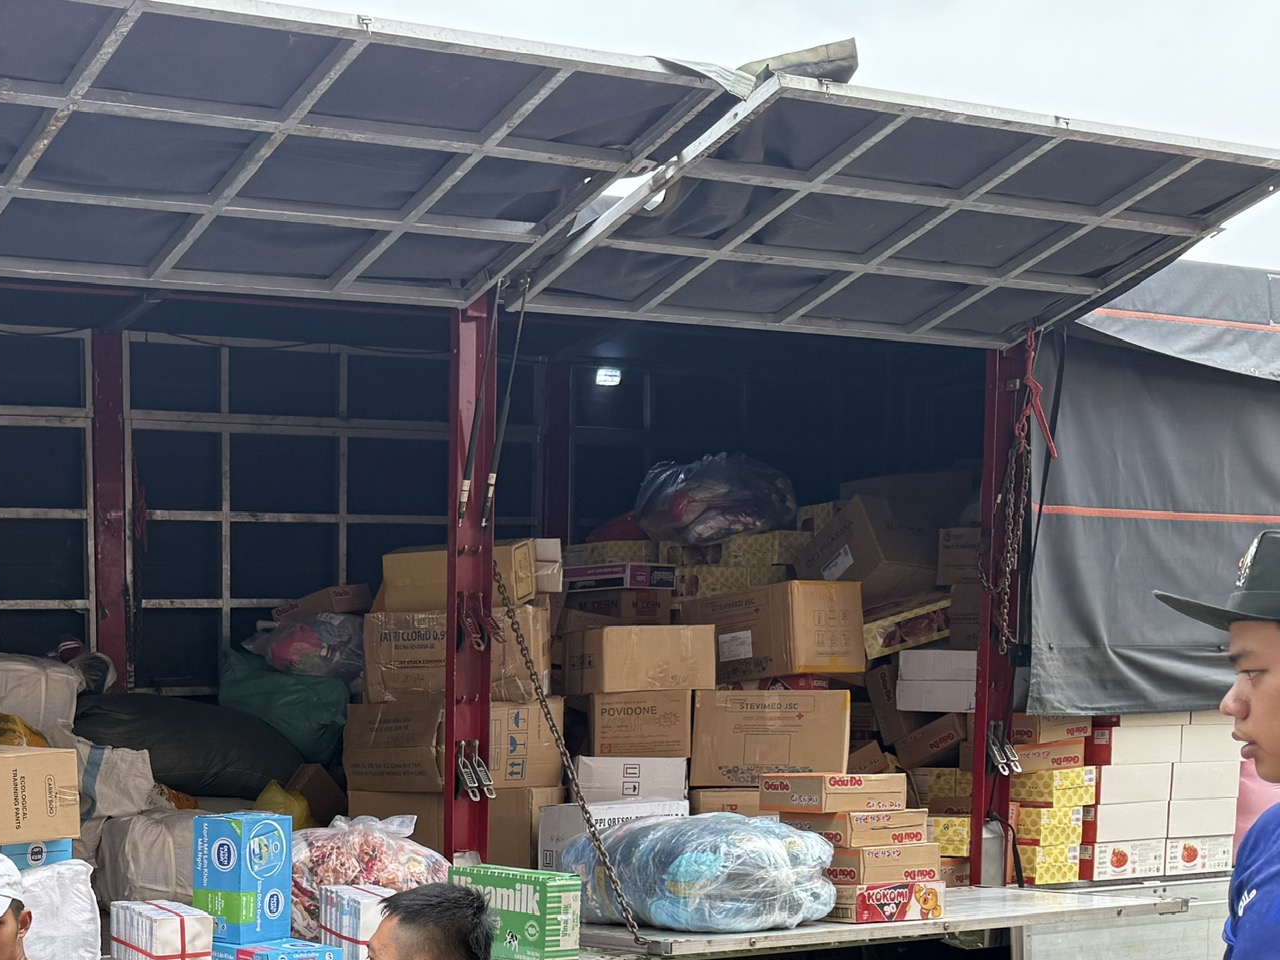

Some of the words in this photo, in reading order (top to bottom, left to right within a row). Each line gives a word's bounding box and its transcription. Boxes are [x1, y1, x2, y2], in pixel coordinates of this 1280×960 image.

[600, 705, 657, 717] POVIDONE
[739, 702, 781, 710] STEVIMED
[784, 702, 799, 710] JSC
[828, 776, 849, 788] Gấu
[849, 775, 863, 787] Đỏ
[20, 775, 28, 821] ECOLOGICAL
[916, 868, 936, 880] Gấu
[866, 888, 908, 904] KOKOMI
[883, 903, 897, 916] 90
